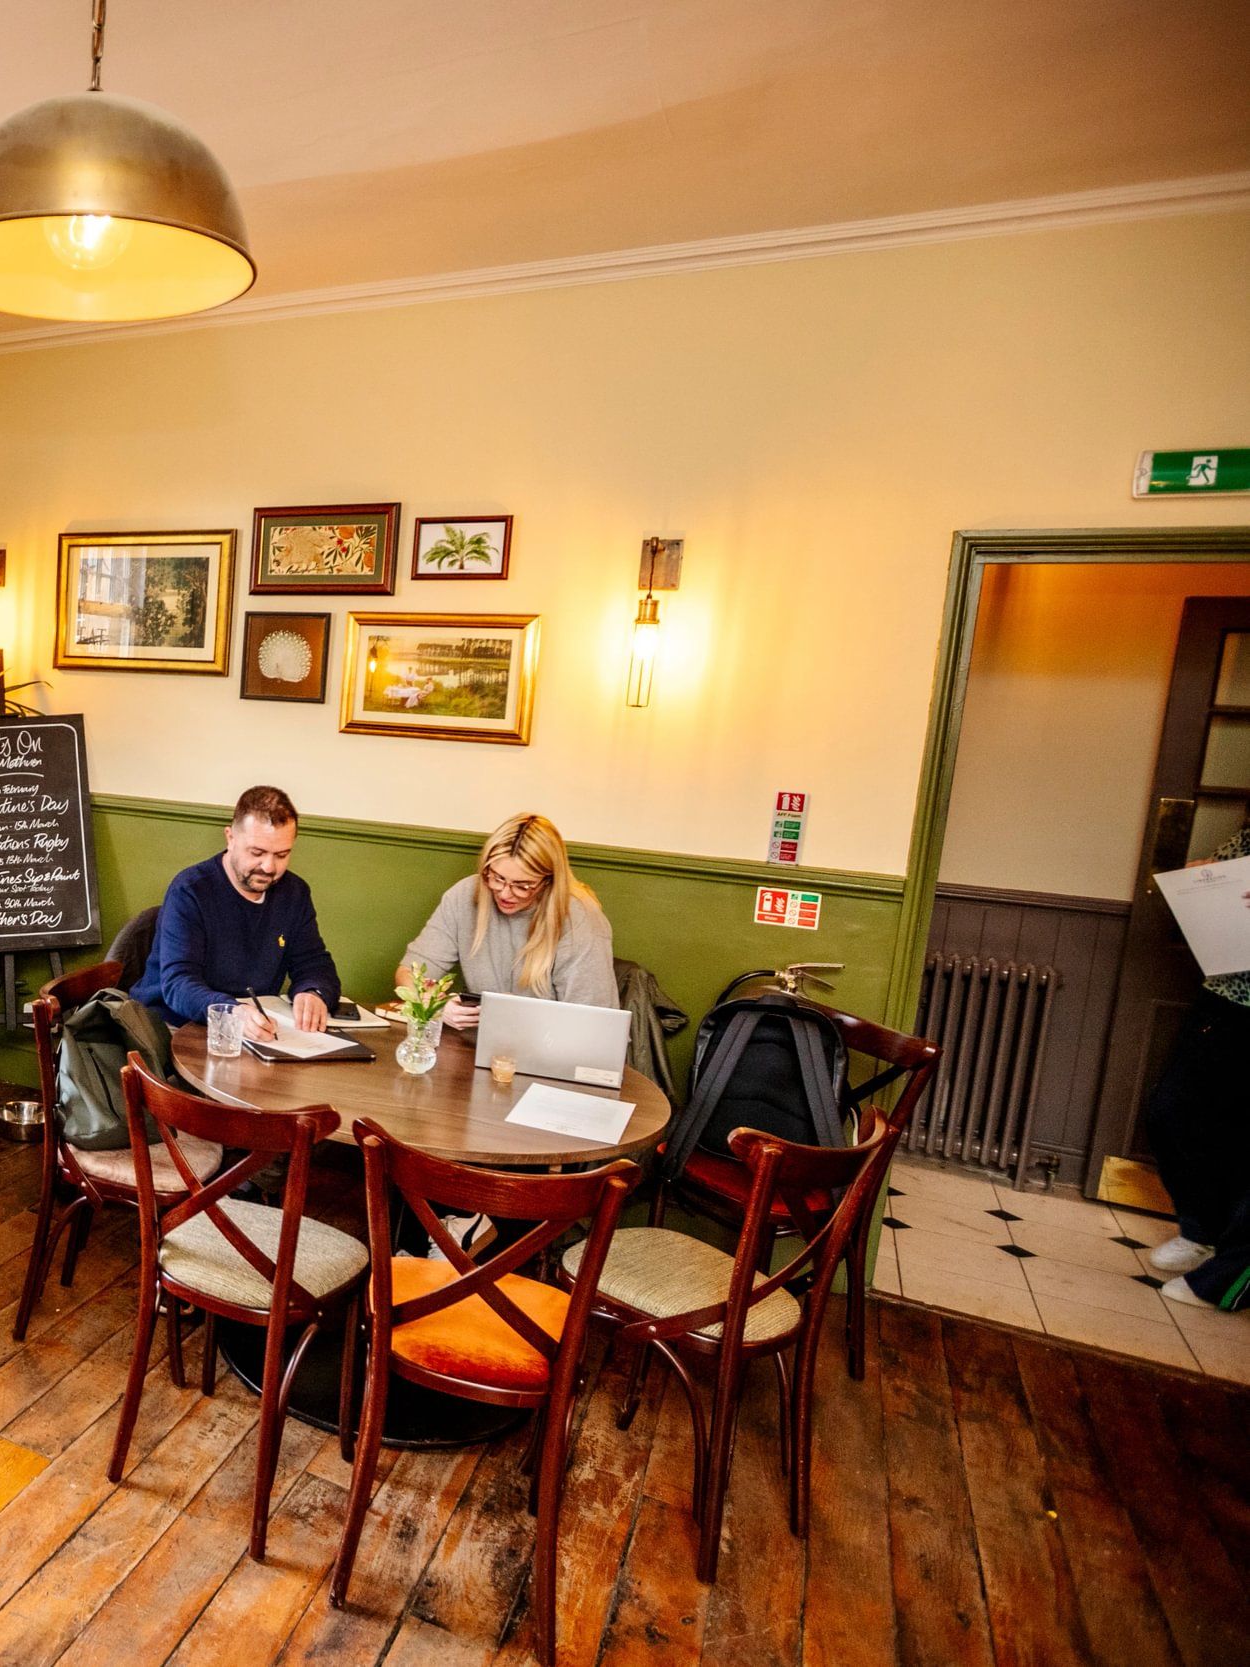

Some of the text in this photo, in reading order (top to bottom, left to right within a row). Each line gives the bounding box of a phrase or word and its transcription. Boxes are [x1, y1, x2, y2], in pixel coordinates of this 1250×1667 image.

[16, 730, 43, 755] On
[2, 784, 39, 797] February
[40, 795, 69, 815] Day
[14, 820, 28, 830] 15th
[29, 818, 59, 830] March
[33, 833, 69, 852] Rugby
[23, 853, 54, 864] March
[23, 897, 55, 908] March
[29, 910, 63, 928] Day
